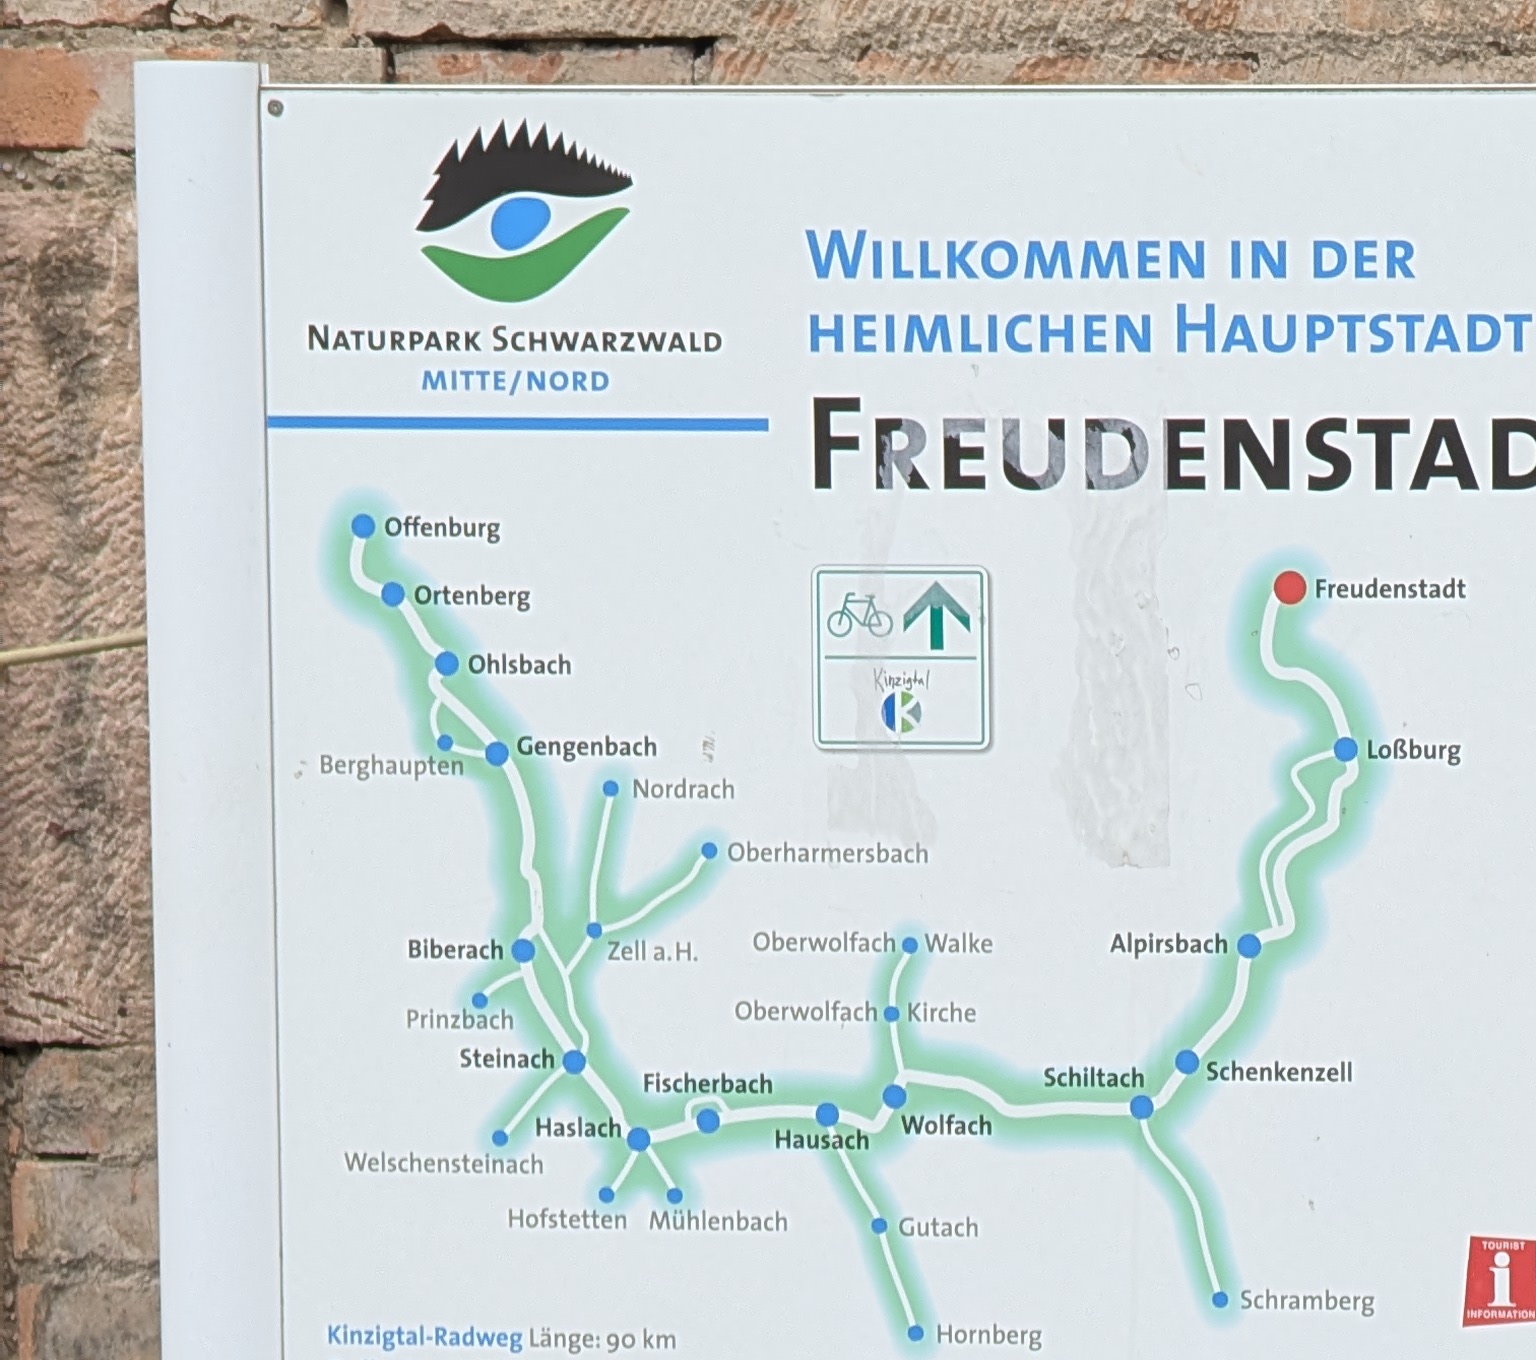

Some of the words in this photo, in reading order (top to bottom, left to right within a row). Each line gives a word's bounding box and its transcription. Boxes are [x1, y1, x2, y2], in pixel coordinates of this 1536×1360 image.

[1231, 241, 1286, 278] IN
[1313, 240, 1415, 278] DER
[810, 314, 1150, 353] HEIMLICHEN
[422, 371, 609, 395] MITTE/NORD
[384, 516, 501, 544] Offenburg
[413, 583, 531, 612] Ortenberg
[1315, 578, 1467, 599] Freudenstadt
[468, 654, 572, 676] Ohlsbach
[517, 736, 658, 762] Gengenbach
[1367, 739, 1461, 766] Loßburg
[320, 754, 464, 781] Berghaupten
[632, 779, 735, 800] Nordrach
[728, 842, 929, 864] Oberharmersbach
[408, 939, 504, 960] Biberach
[608, 941, 647, 961] Zell
[752, 931, 896, 953] Oberwolfach
[925, 933, 993, 954] Walke
[1110, 932, 1228, 959] Alpirsbach
[407, 1009, 514, 1031] Prinzbach
[734, 1000, 878, 1022] Oberwolfach
[907, 1002, 977, 1023] Kirche
[459, 1049, 555, 1069] Steinach
[1043, 1067, 1145, 1089] Schiltach
[1206, 1061, 1353, 1083] Schenkenzell
[643, 1073, 773, 1094] Fischerbach
[535, 1117, 622, 1139] Haslach
[901, 1115, 992, 1136] Wolfach
[775, 1130, 870, 1150] Hausach
[344, 1151, 544, 1175] Welschensteinach
[508, 1208, 627, 1230] Hofstetten
[649, 1210, 788, 1232] Mühlenbach
[899, 1217, 979, 1238] Gutach
[1482, 1241, 1525, 1251] TOURIST
[1241, 1289, 1374, 1317] Schramberg
[1467, 1308, 1536, 1319] INFORMATION
[329, 1324, 522, 1353] Kinzigtal-Radweg
[530, 1327, 600, 1354] Länge:
[607, 1334, 635, 1353] 90
[644, 1328, 676, 1349] km
[937, 1324, 1041, 1351] Hornberg
